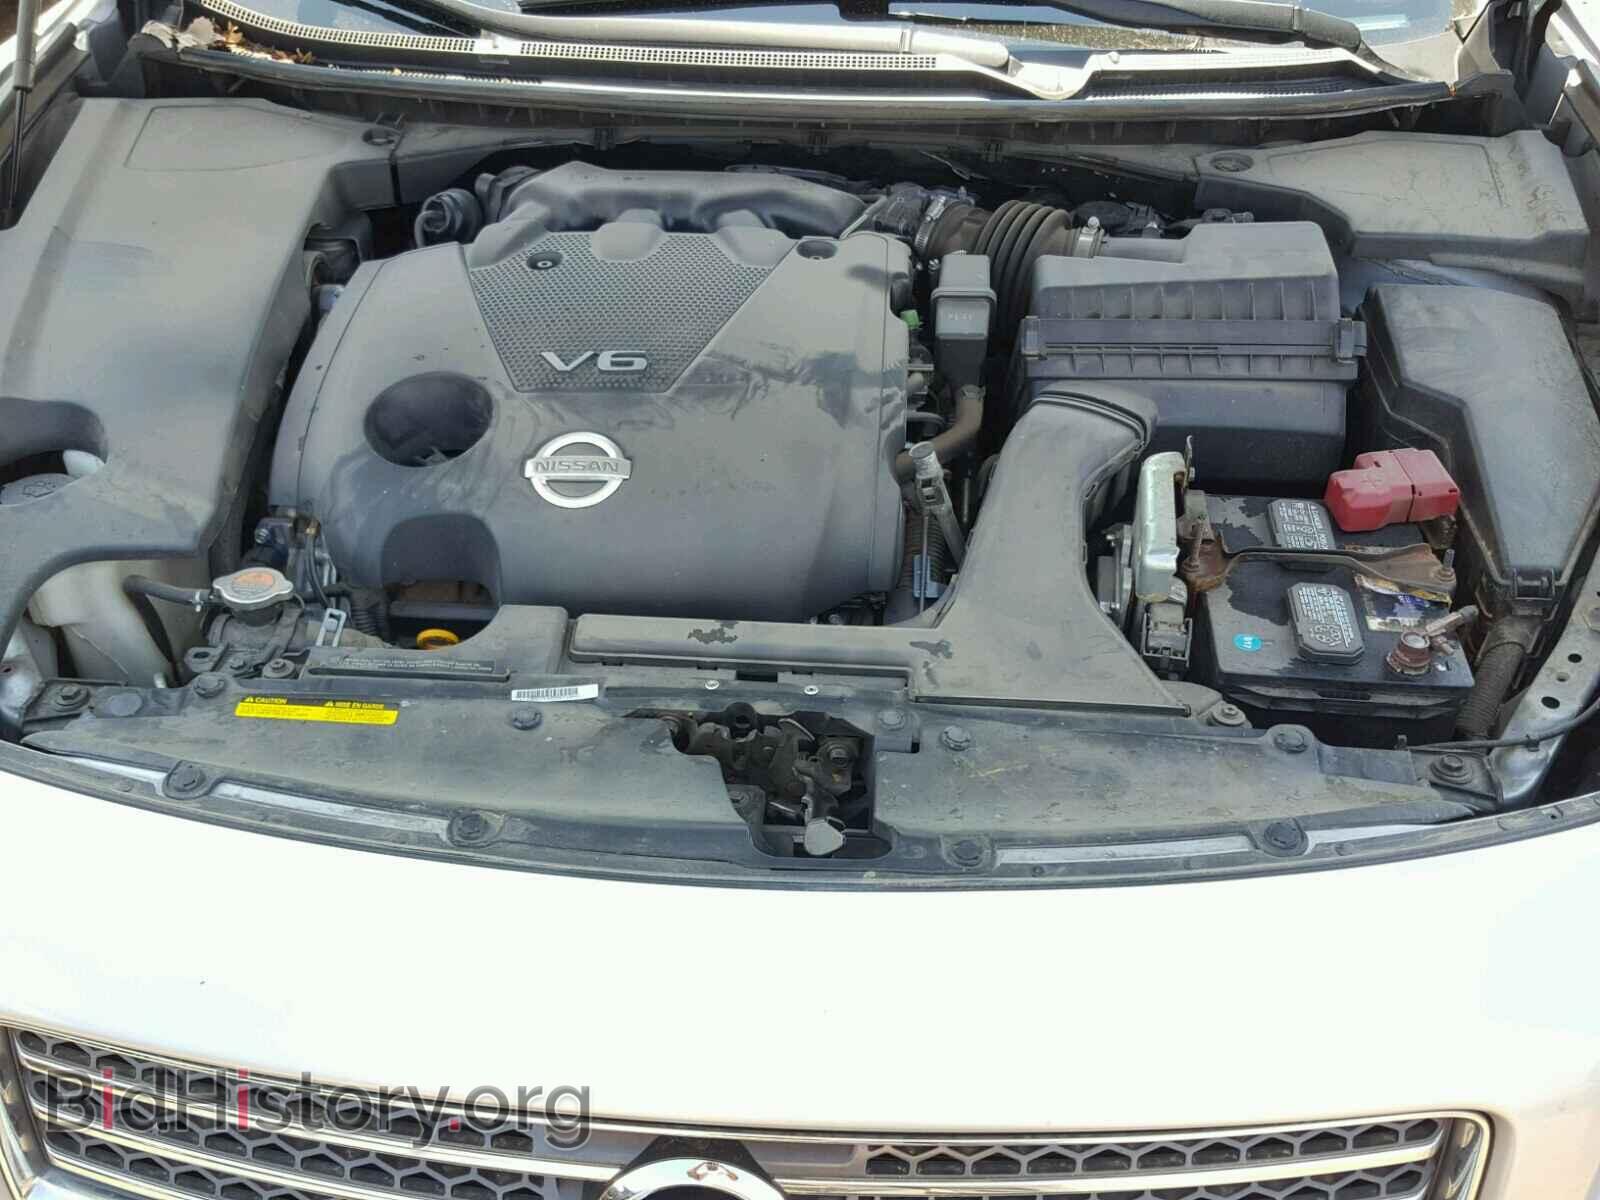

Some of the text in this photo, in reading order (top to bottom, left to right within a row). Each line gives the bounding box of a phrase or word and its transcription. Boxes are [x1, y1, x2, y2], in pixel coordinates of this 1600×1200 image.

[540, 350, 648, 372] V6
[535, 460, 619, 473] NISSAN
[255, 696, 288, 704] CAUTION
